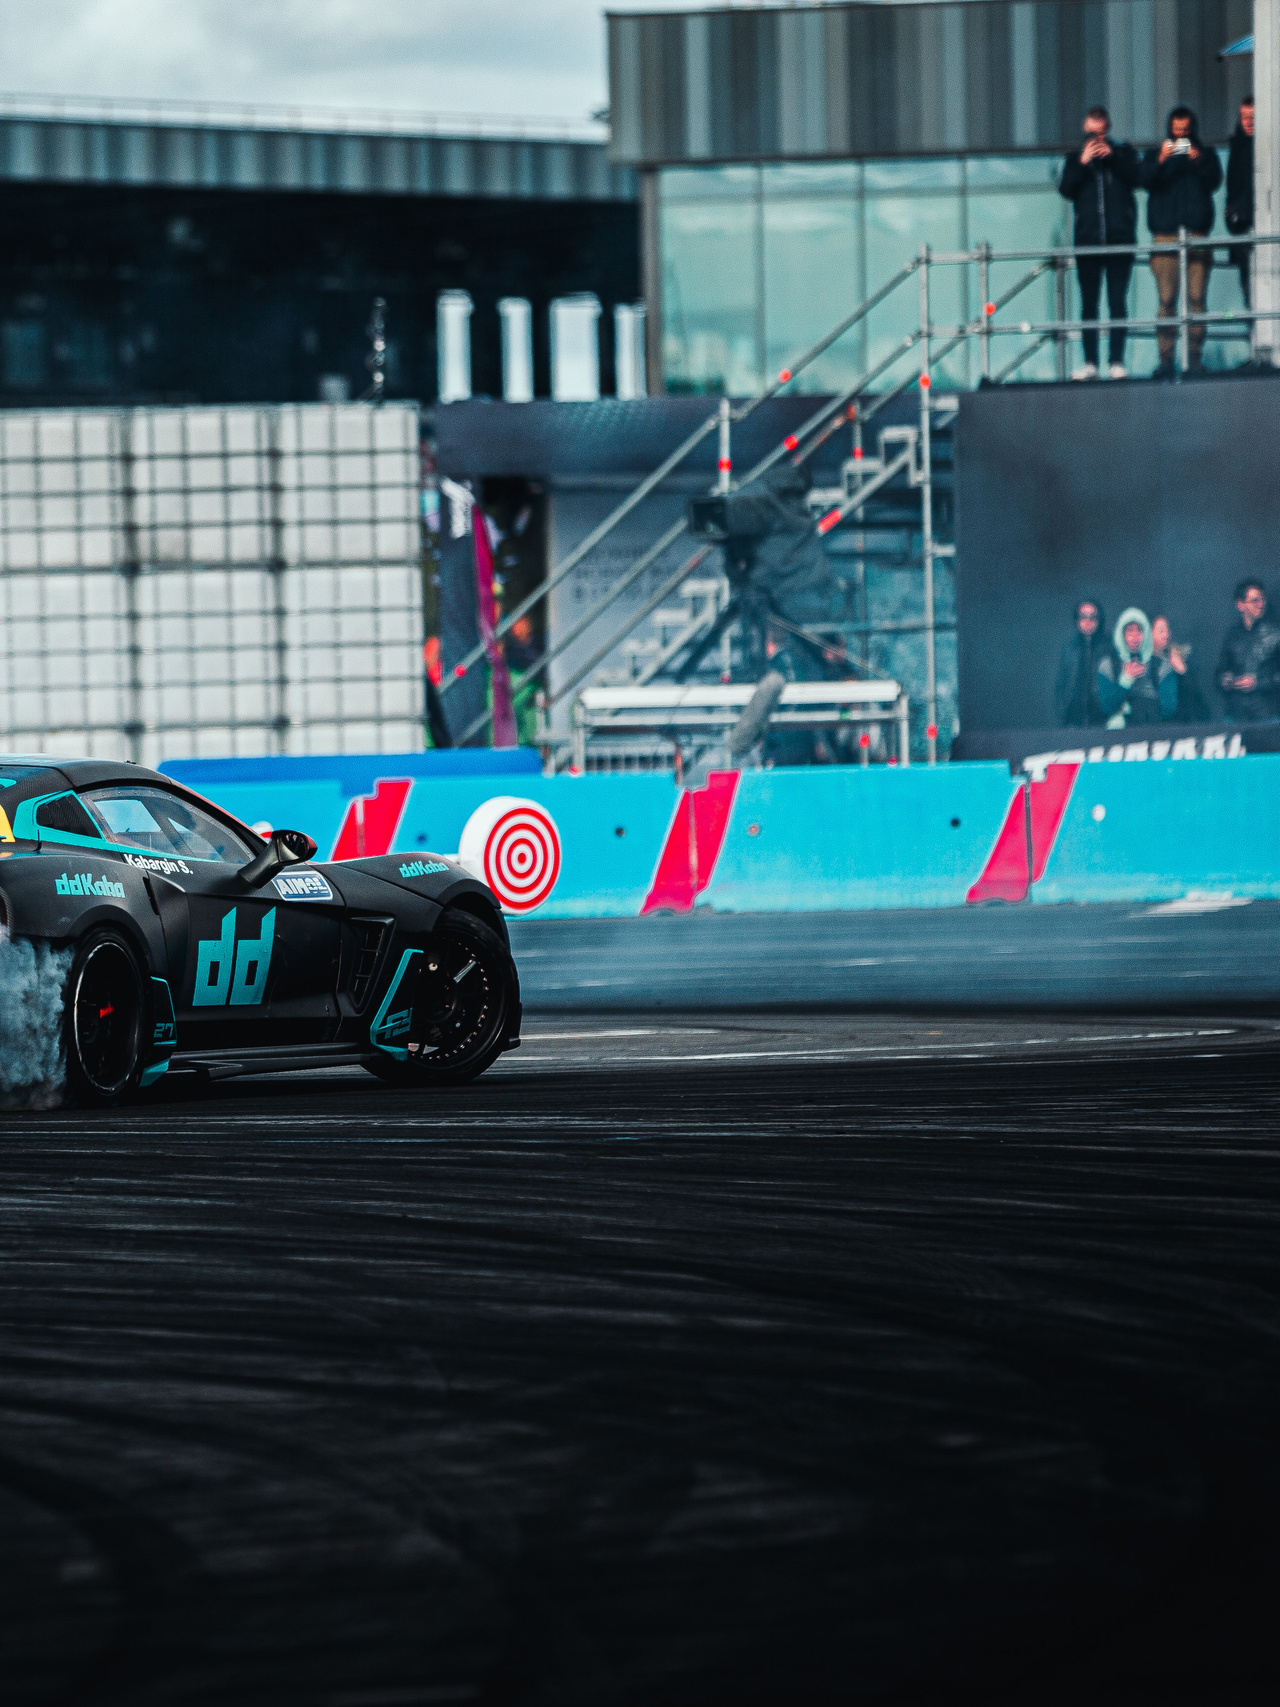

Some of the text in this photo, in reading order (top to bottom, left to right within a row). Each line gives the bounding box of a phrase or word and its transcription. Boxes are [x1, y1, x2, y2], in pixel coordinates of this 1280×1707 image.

[123, 853, 194, 875] Kabargin S.
[399, 860, 450, 878] ddKaba
[55, 872, 126, 898] ddKaba
[192, 905, 277, 1007] dd
[153, 1022, 174, 1038] 27
